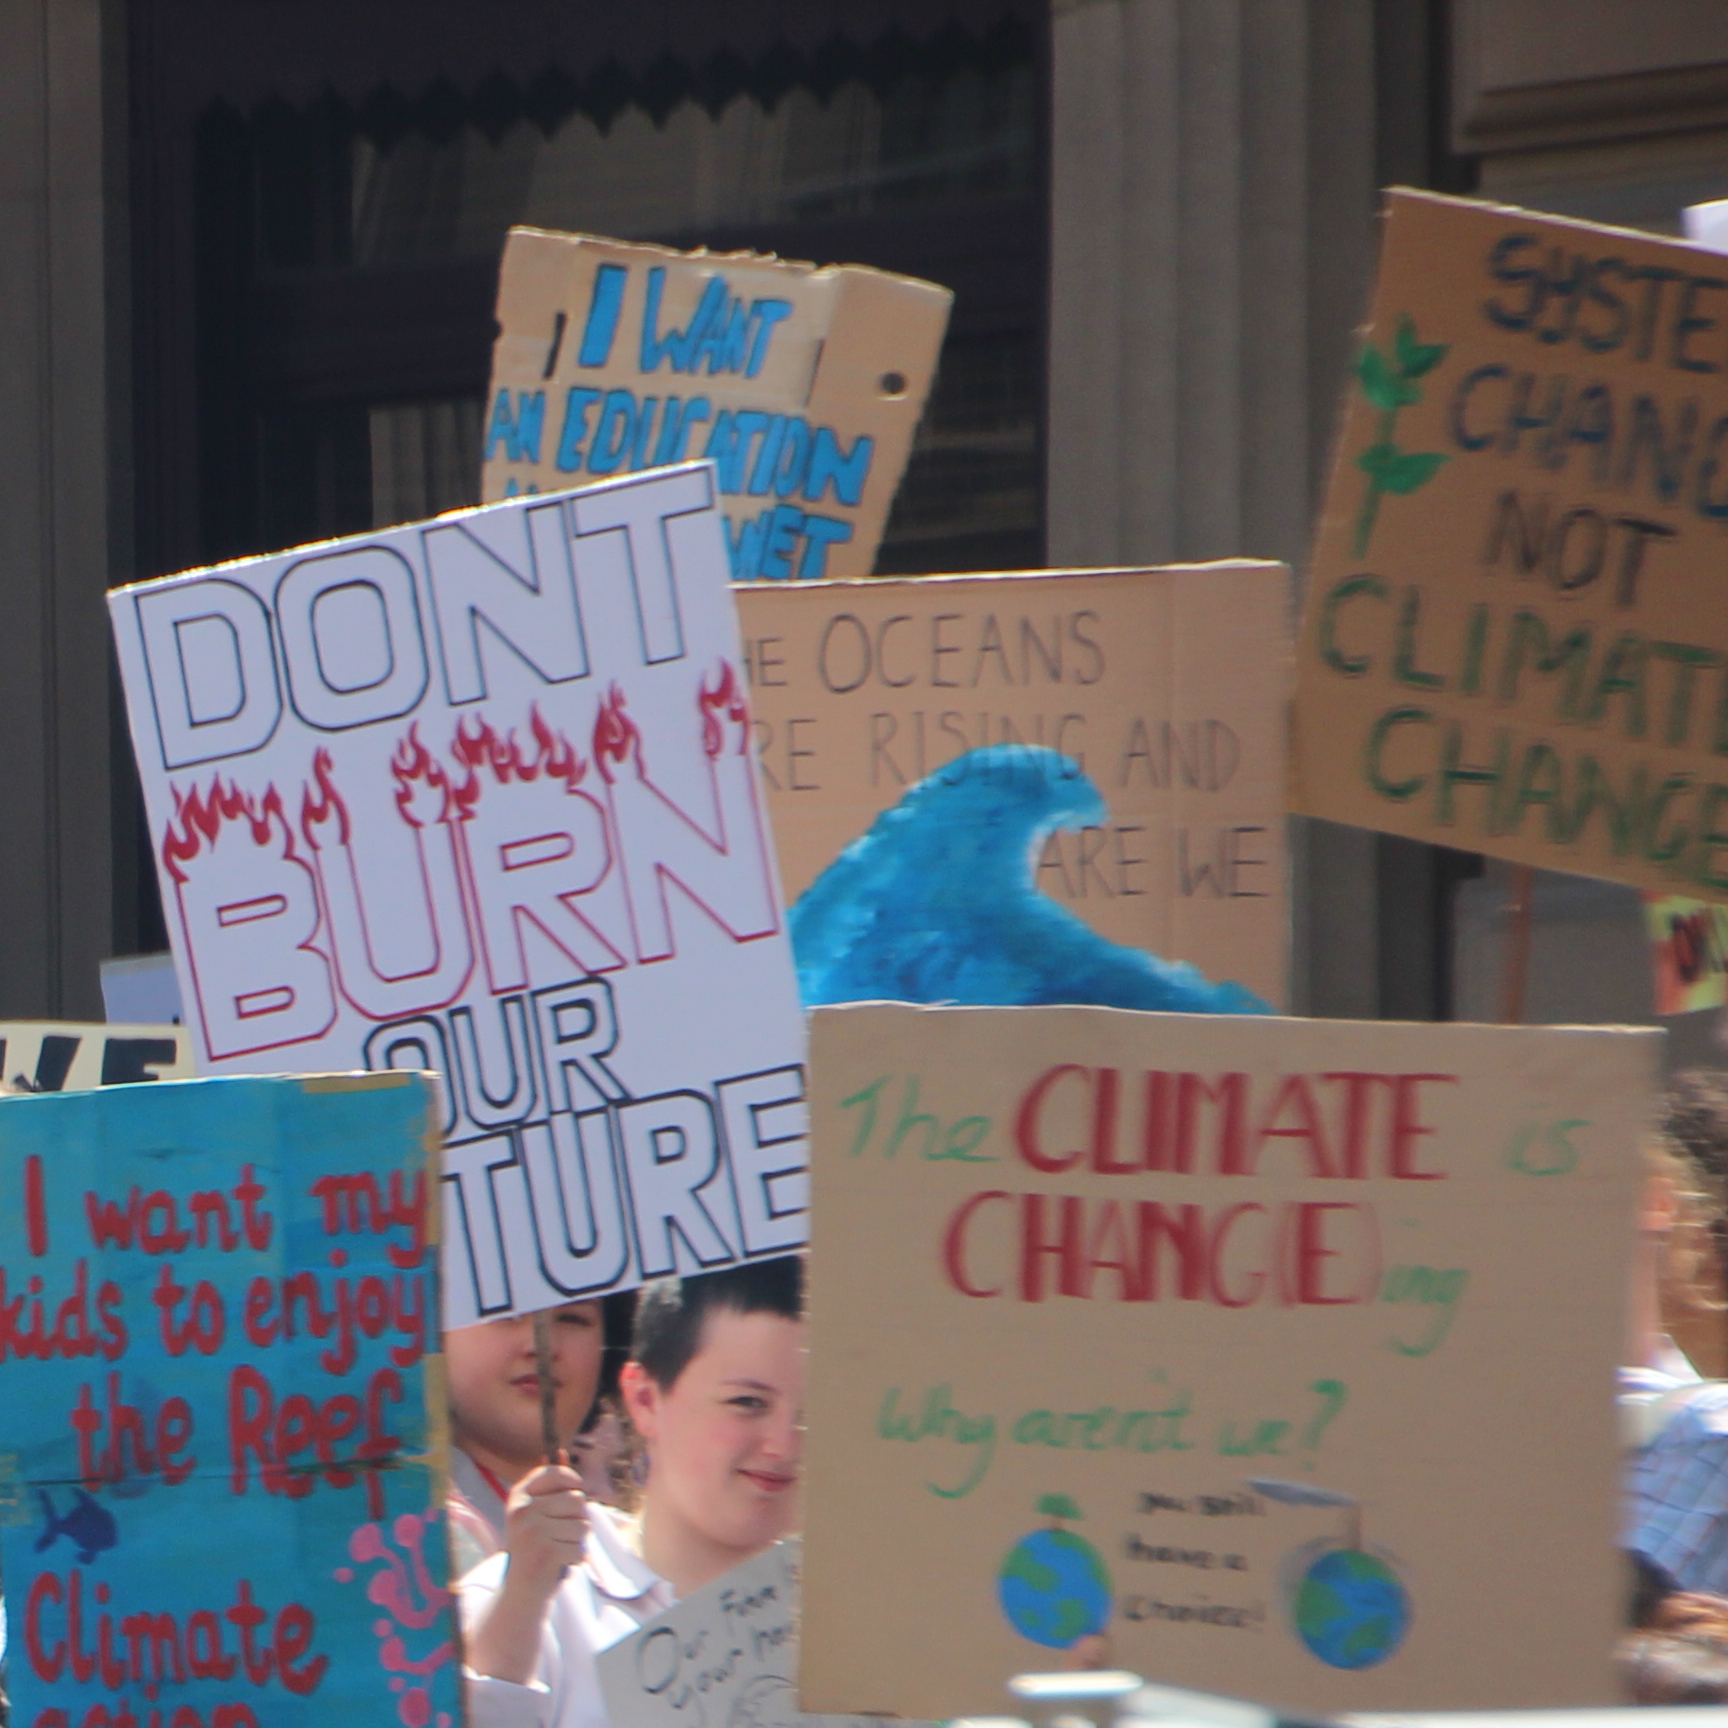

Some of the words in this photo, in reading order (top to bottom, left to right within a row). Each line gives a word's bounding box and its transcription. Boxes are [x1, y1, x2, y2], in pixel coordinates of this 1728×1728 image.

[578, 262, 629, 367] I
[640, 266, 794, 379] WANT
[485, 386, 546, 464] AN
[555, 386, 875, 507] EDUCATION
[1484, 490, 1680, 610] NOT
[134, 465, 715, 771] DONT
[818, 610, 1109, 695] OCEANS
[868, 710, 1090, 790] RISING
[1121, 718, 1243, 793] AND
[159, 665, 782, 1063] BURN
[1040, 826, 1148, 898] ARE
[1180, 826, 1270, 899] WE
[363, 974, 632, 1137] OUR
[838, 1074, 1002, 1164] The
[1013, 1062, 1461, 1182] CLIMATE
[1501, 1116, 1592, 1176] is
[23, 1154, 47, 1258] I
[84, 1164, 274, 1258] want
[312, 1169, 430, 1271] my
[153, 1264, 227, 1358] to
[243, 1251, 432, 1378] enjoy
[69, 1370, 196, 1491] the
[229, 1364, 406, 1520] Reef
[23, 1571, 330, 1696] Climate
